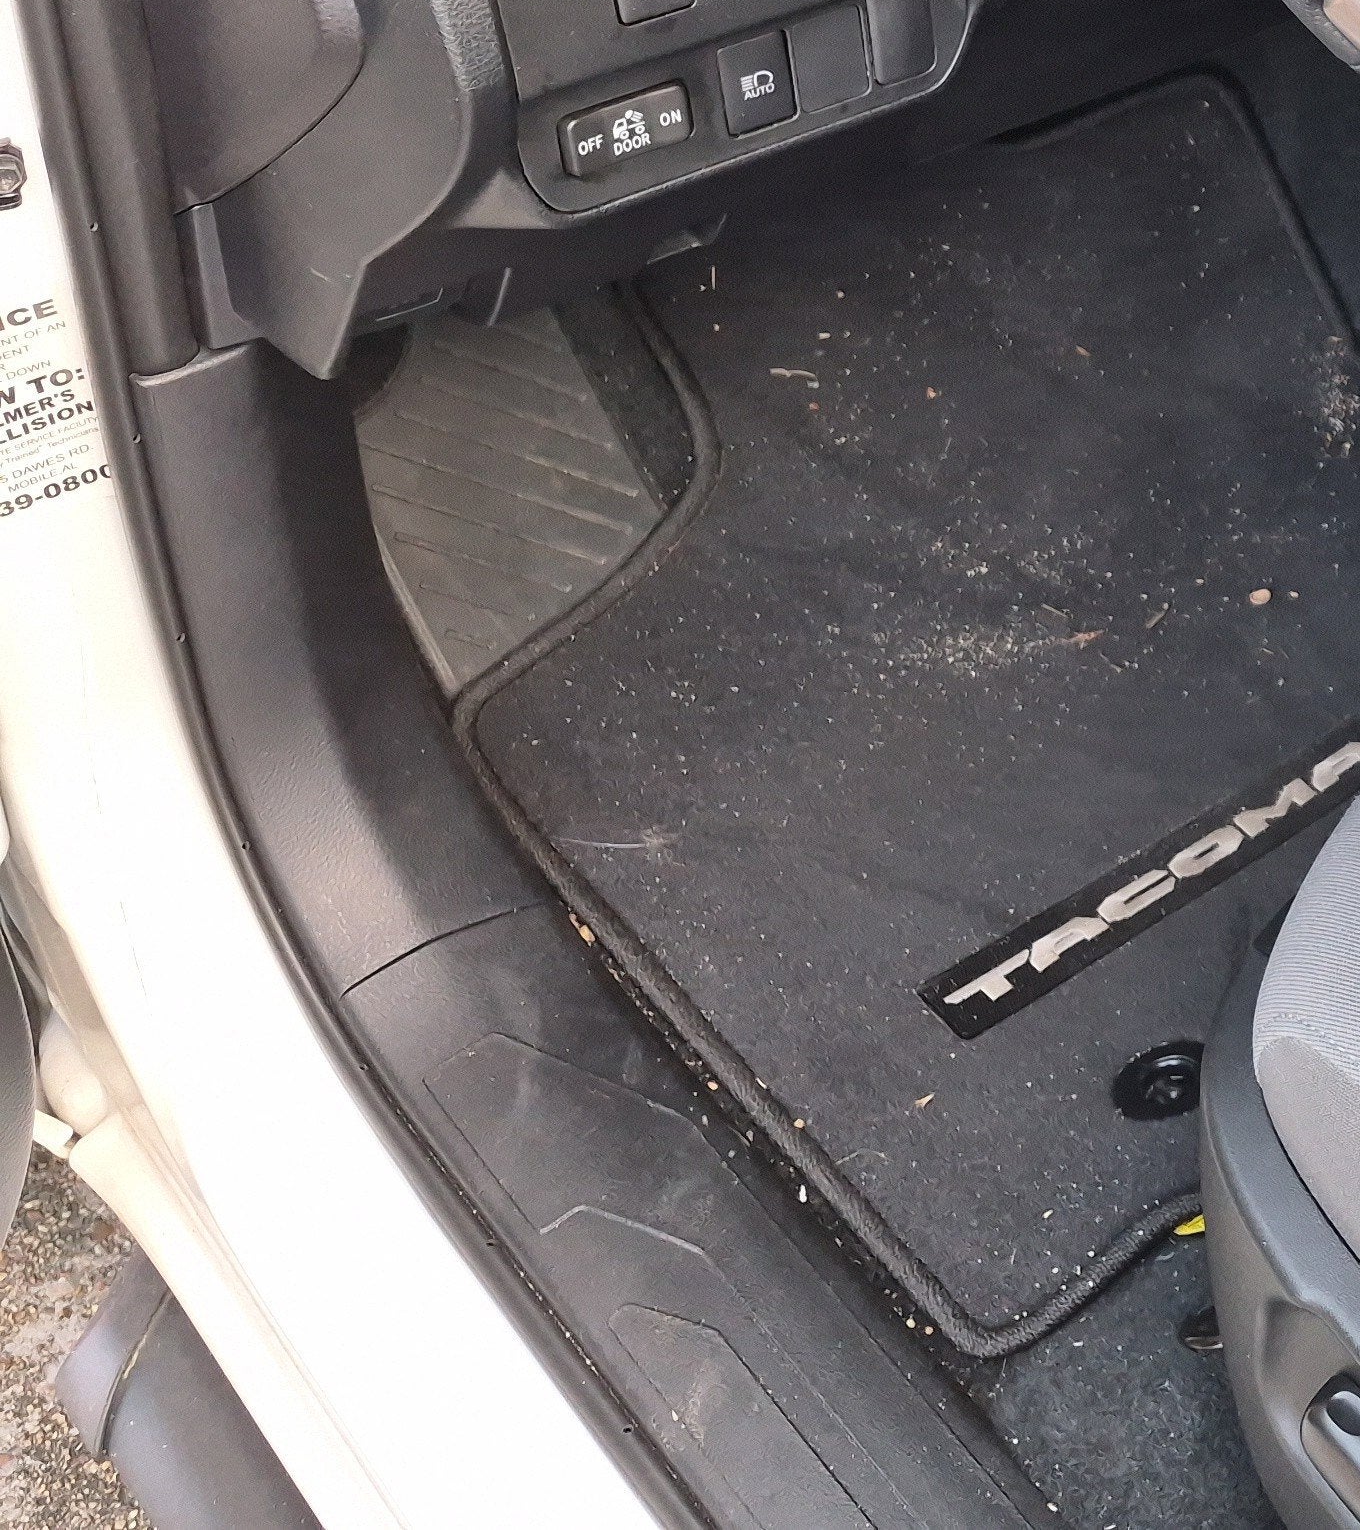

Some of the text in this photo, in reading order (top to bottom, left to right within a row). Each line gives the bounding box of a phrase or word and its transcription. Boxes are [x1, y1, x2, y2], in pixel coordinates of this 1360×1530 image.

[744, 82, 775, 101] AUTO
[659, 109, 683, 127] ON
[578, 134, 604, 156] OFF
[613, 133, 651, 157] DOOR
[47, 320, 67, 333] AN
[0, 345, 30, 360] ENT
[6, 360, 51, 380] DOWN
[26, 368, 85, 394] TO:
[0, 389, 75, 427] MER'S
[12, 453, 66, 480] DAWES
